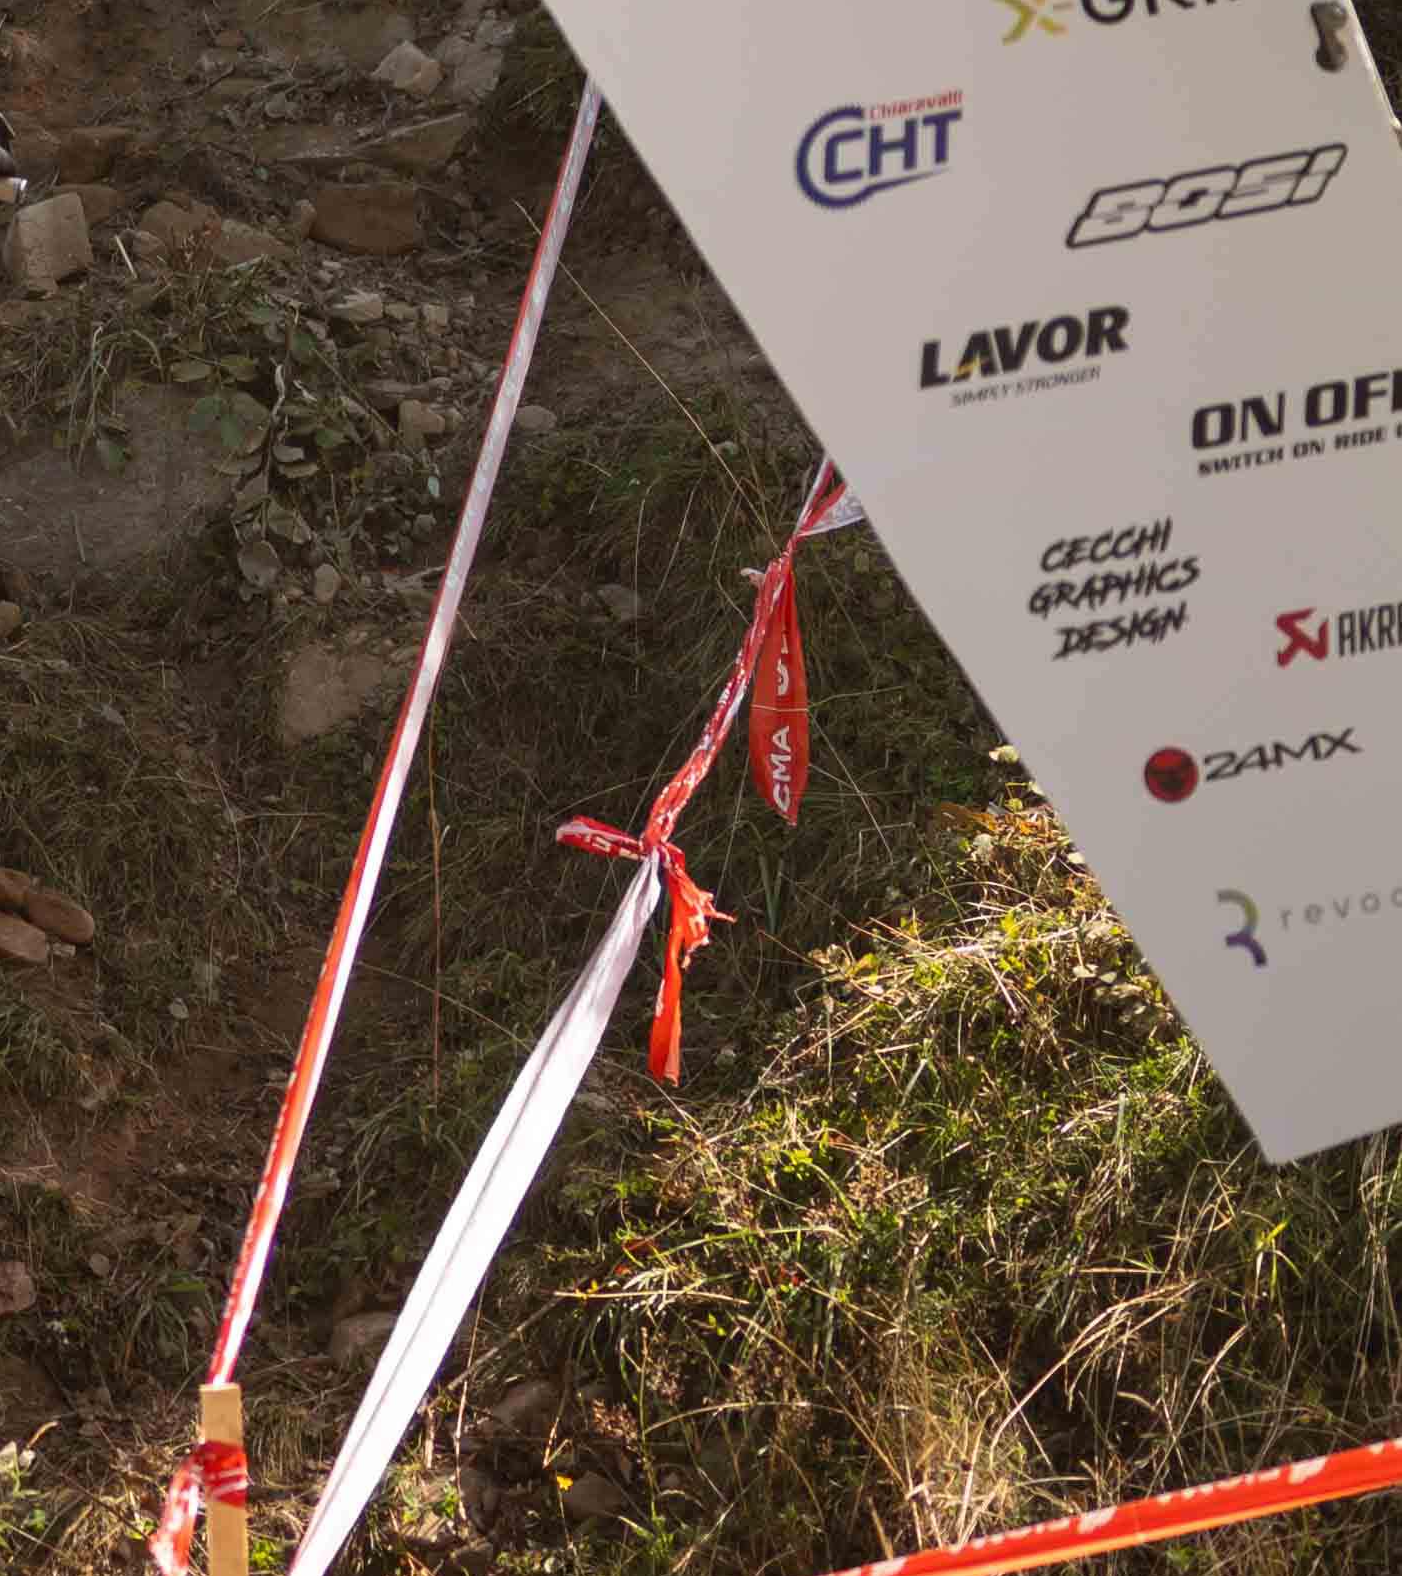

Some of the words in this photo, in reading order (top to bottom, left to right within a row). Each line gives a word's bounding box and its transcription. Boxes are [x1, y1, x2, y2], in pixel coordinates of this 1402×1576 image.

[918, 305, 1131, 391] LAVOR
[951, 381, 1009, 408] SIMPLY
[1014, 365, 1102, 397] STRONGER
[1191, 390, 1286, 452] ON
[1198, 447, 1285, 478] SWITCH
[1293, 437, 1326, 459] ON
[1334, 427, 1388, 451] RIDE
[1040, 518, 1173, 572] CECCHI
[1028, 553, 1201, 616] GRAPHICS
[1051, 609, 1188, 660] DESIGN
[1338, 601, 1402, 658] AKR
[1204, 726, 1364, 783] 24MX
